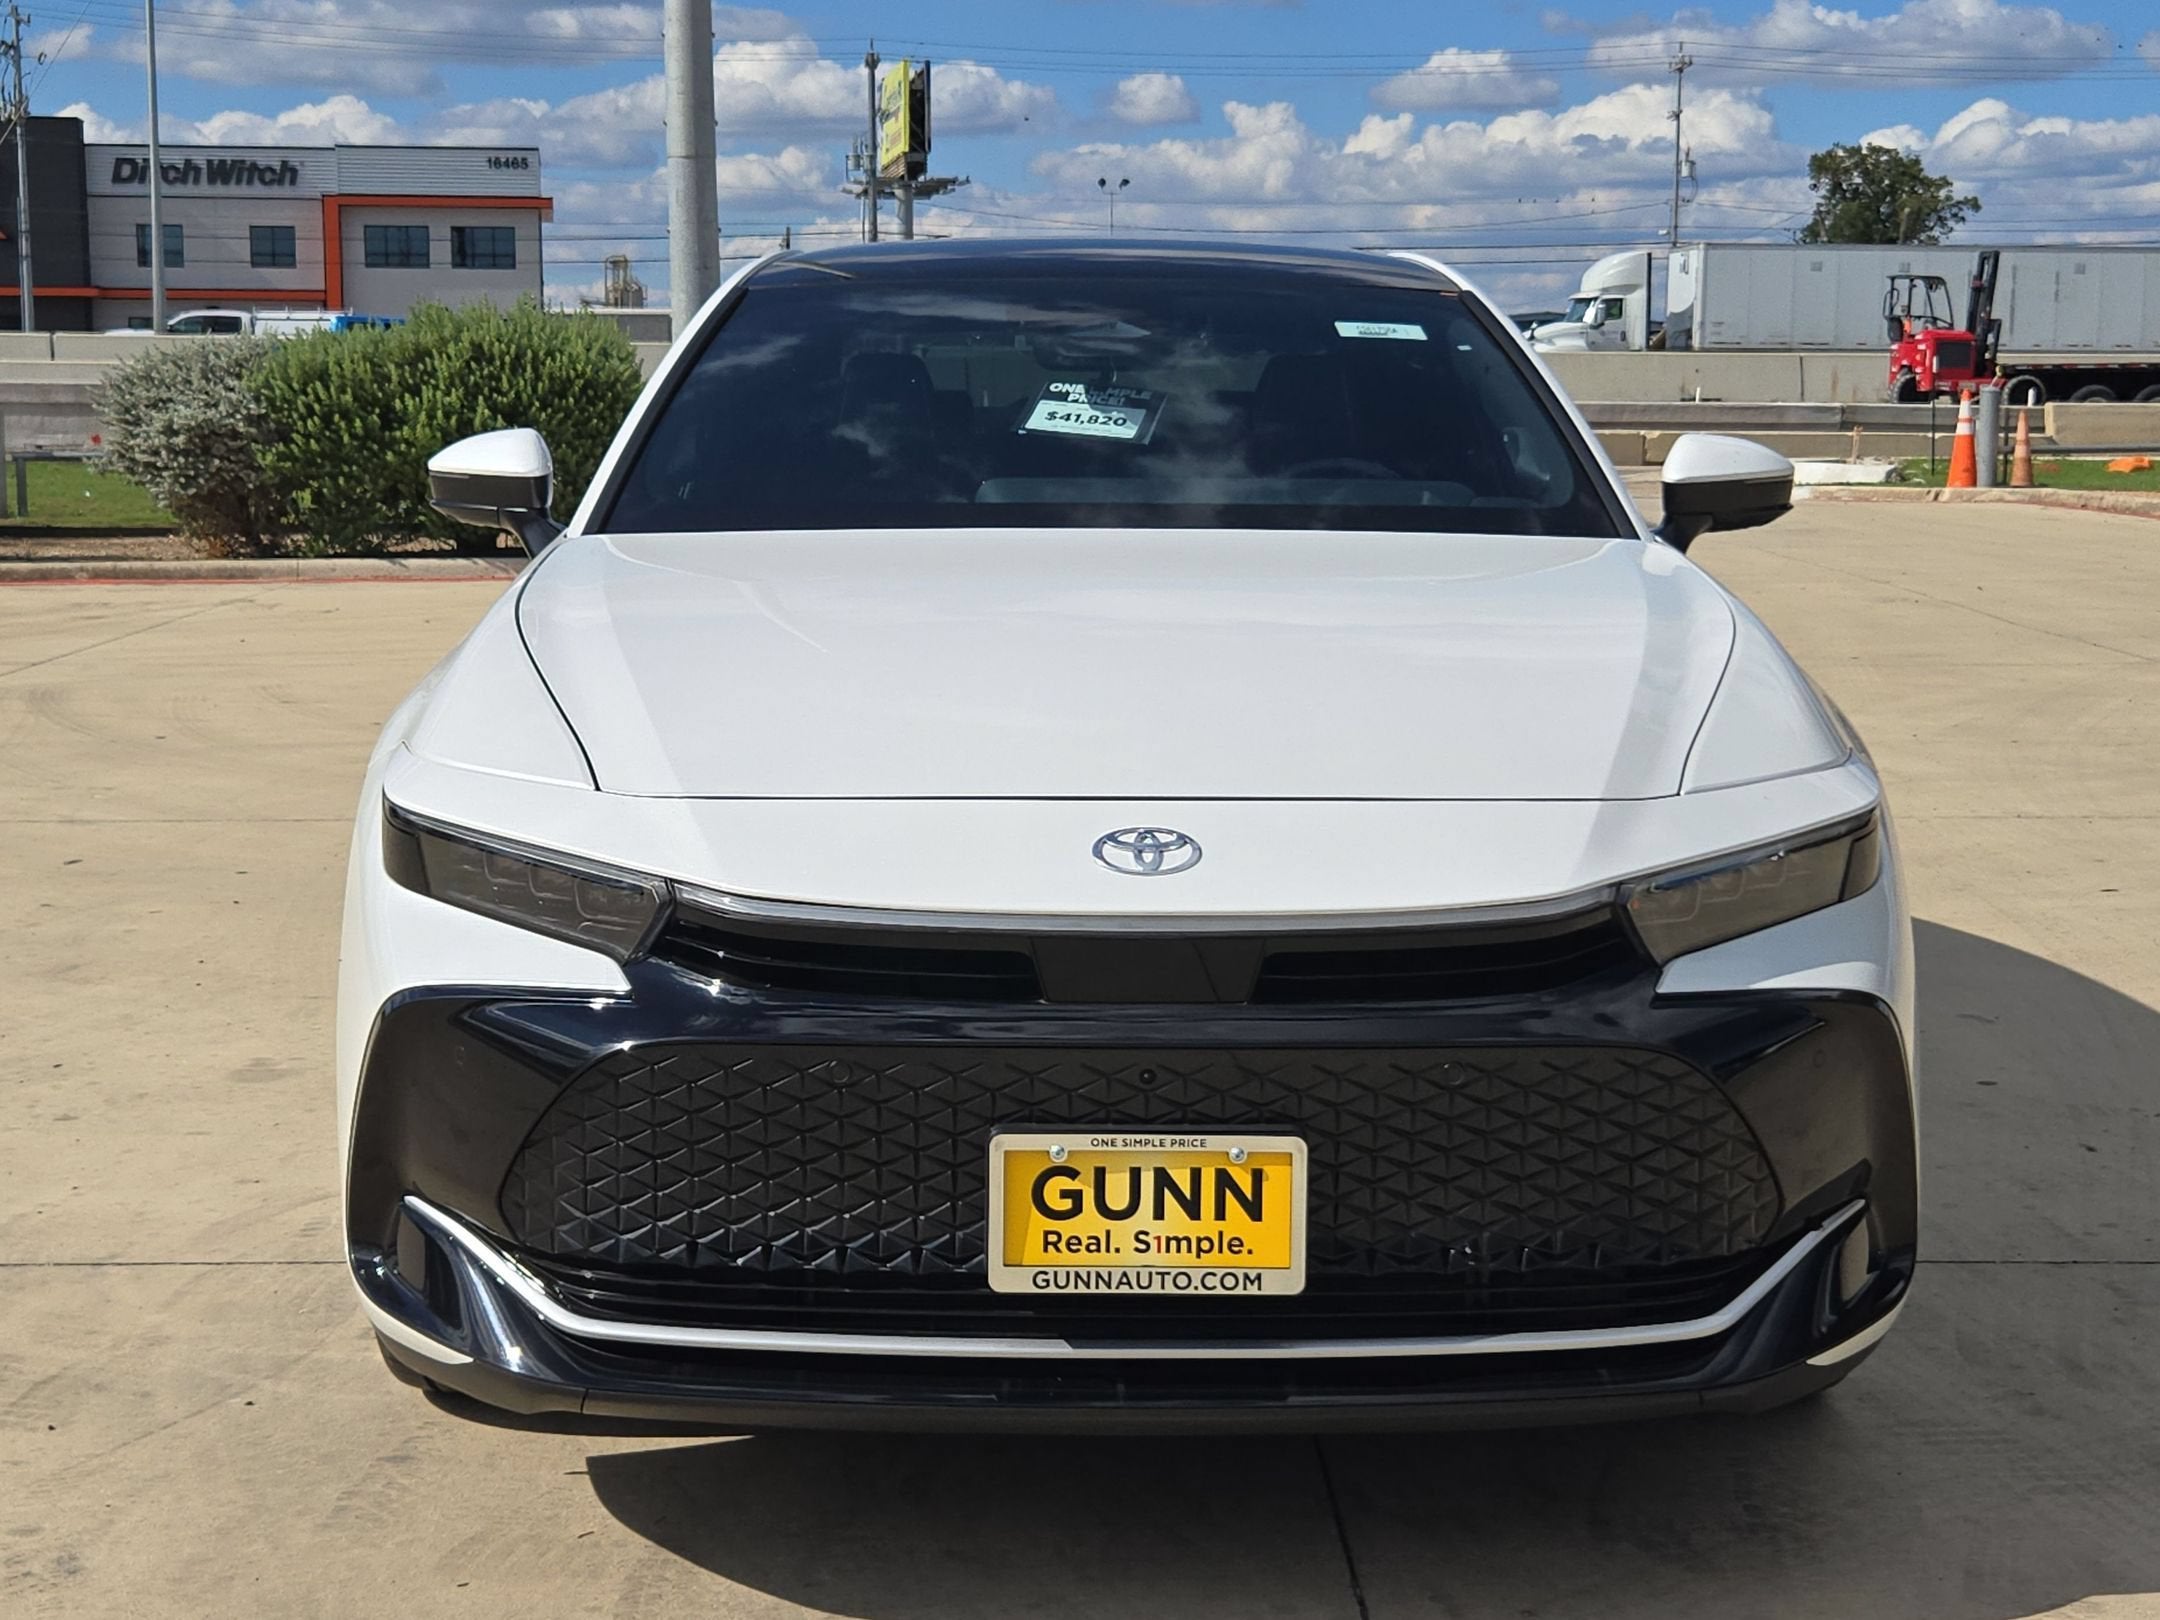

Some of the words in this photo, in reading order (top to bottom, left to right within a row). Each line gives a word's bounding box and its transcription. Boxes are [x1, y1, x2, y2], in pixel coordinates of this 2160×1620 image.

[111, 157, 202, 186] Dich
[204, 158, 299, 187] Witch
[486, 156, 529, 170] 16465
[1049, 382, 1086, 395] ONE
[1045, 410, 1128, 428] $41,820
[1090, 1138, 1118, 1148] ONE
[1121, 1138, 1167, 1148] SIMPLE
[1170, 1138, 1208, 1149] PRICE
[1030, 1164, 1264, 1223] GUNN
[1042, 1229, 1121, 1254] Real.
[1031, 1270, 1263, 1292] GUNNAUTO.COM
